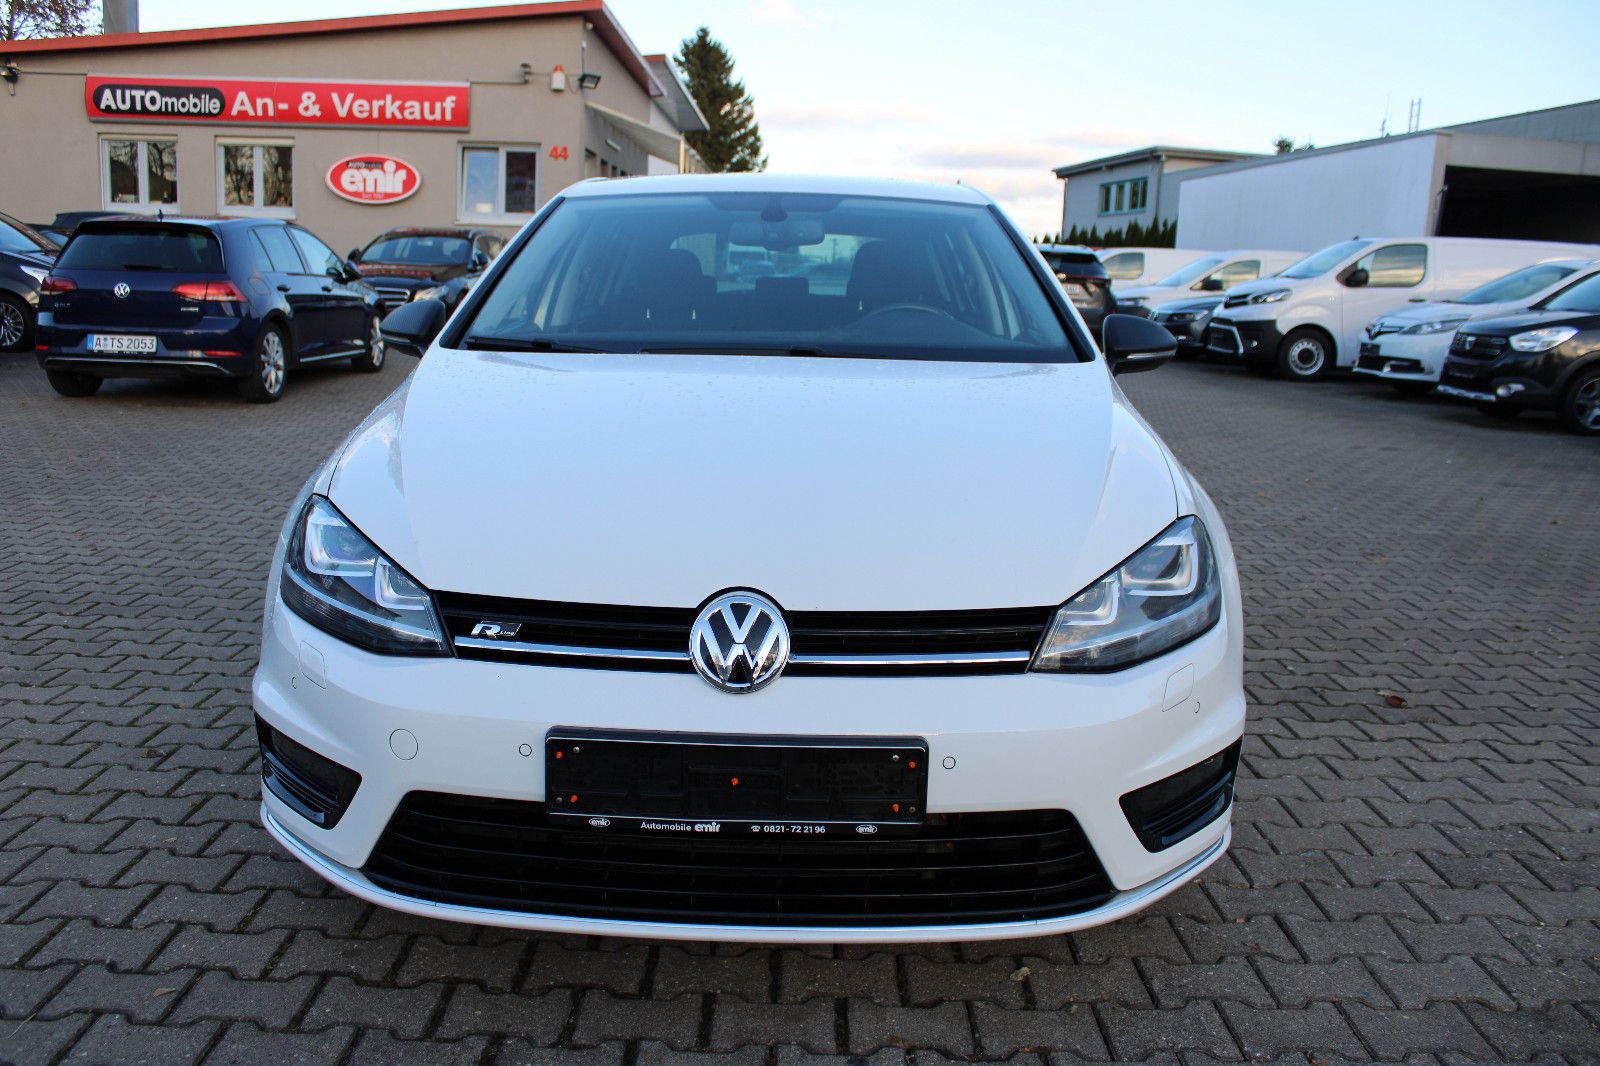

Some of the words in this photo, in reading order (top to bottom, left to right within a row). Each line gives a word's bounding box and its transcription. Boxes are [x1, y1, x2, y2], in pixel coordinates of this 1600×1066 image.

[99, 88, 220, 115] AUTOmobile
[231, 91, 289, 118] An-
[298, 91, 322, 118] &
[331, 92, 456, 121] Verkauf
[548, 145, 569, 161] 44
[340, 159, 407, 194] emir
[95, 337, 102, 349] A
[110, 337, 124, 350] TS
[126, 338, 155, 350] 2053
[640, 821, 692, 832] Automobile
[694, 821, 721, 833] emir
